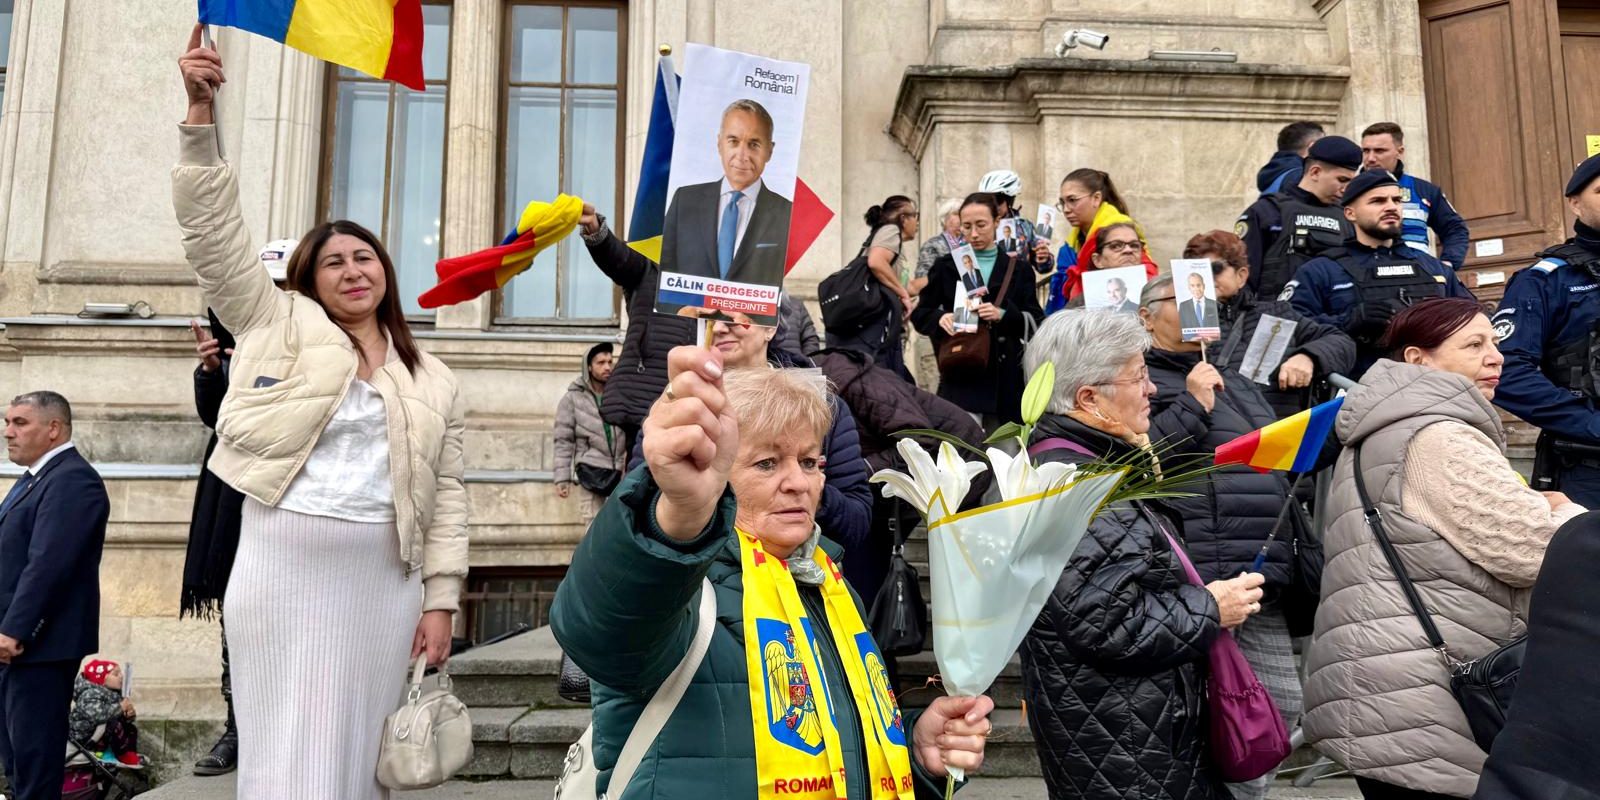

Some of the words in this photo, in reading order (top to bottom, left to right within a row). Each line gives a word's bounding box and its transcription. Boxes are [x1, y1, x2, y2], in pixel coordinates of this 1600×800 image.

[745, 75, 793, 95] România
[755, 67, 795, 83] Refacem
[666, 276, 704, 291] CĂLIN
[706, 283, 776, 299] GEORGESCU
